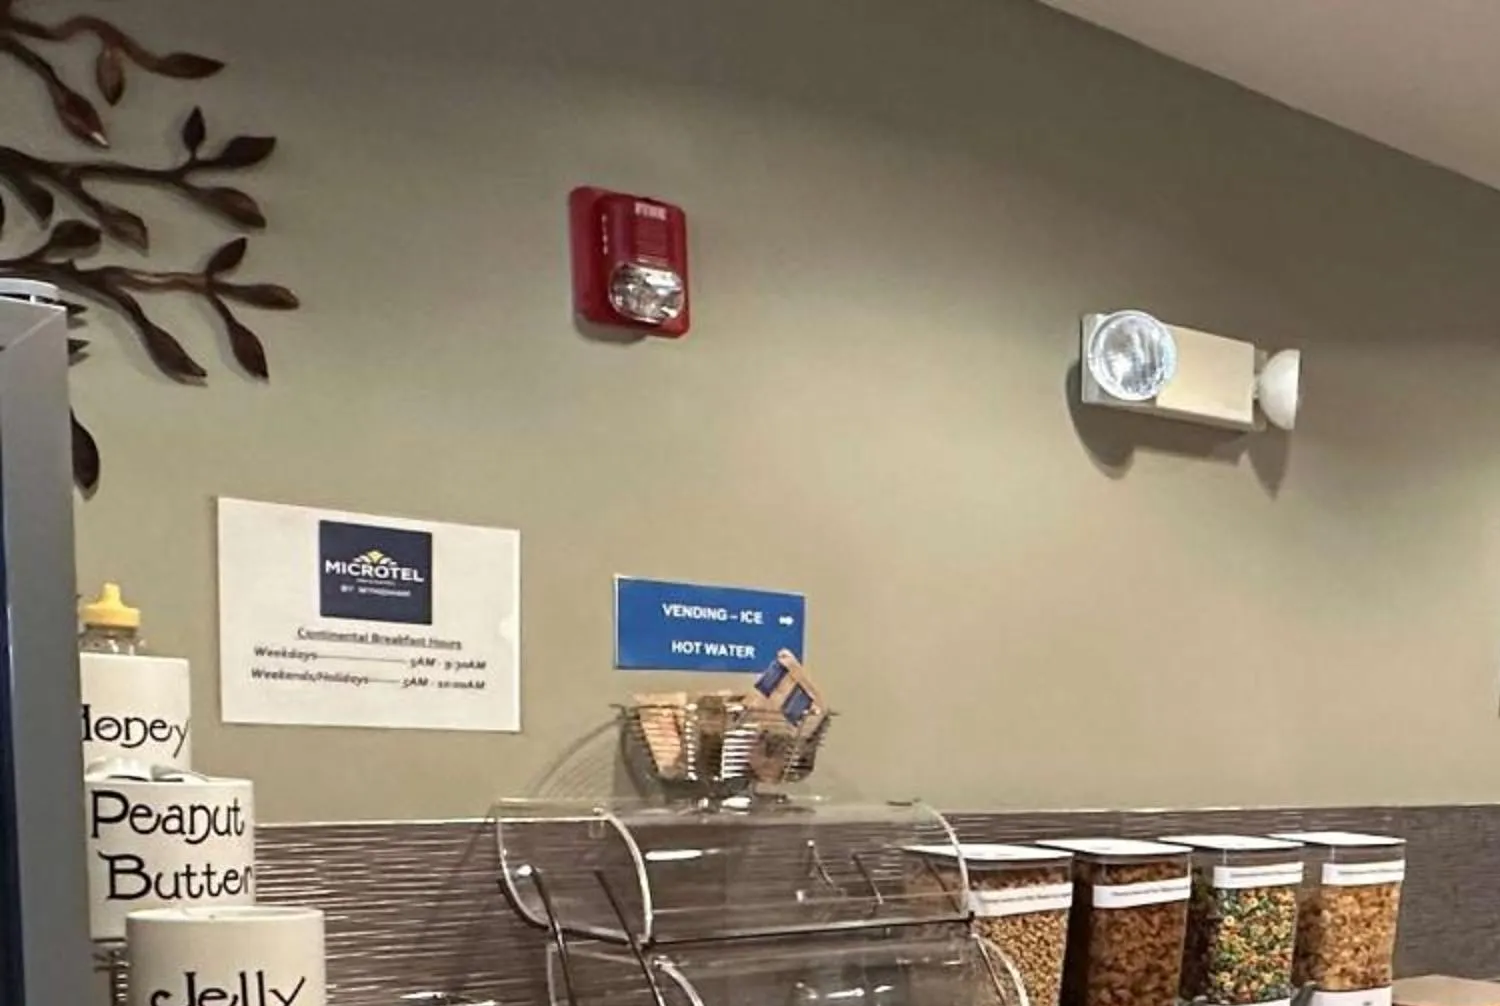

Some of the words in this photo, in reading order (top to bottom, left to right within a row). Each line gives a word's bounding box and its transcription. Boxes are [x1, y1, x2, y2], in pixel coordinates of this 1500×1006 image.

[325, 559, 424, 582] MICROTEL
[662, 603, 727, 621] VENDING
[740, 611, 763, 625] ICE
[671, 640, 702, 654] HOT
[704, 644, 756, 658] WATER
[91, 789, 245, 844] Peanut
[98, 851, 253, 901] Butter
